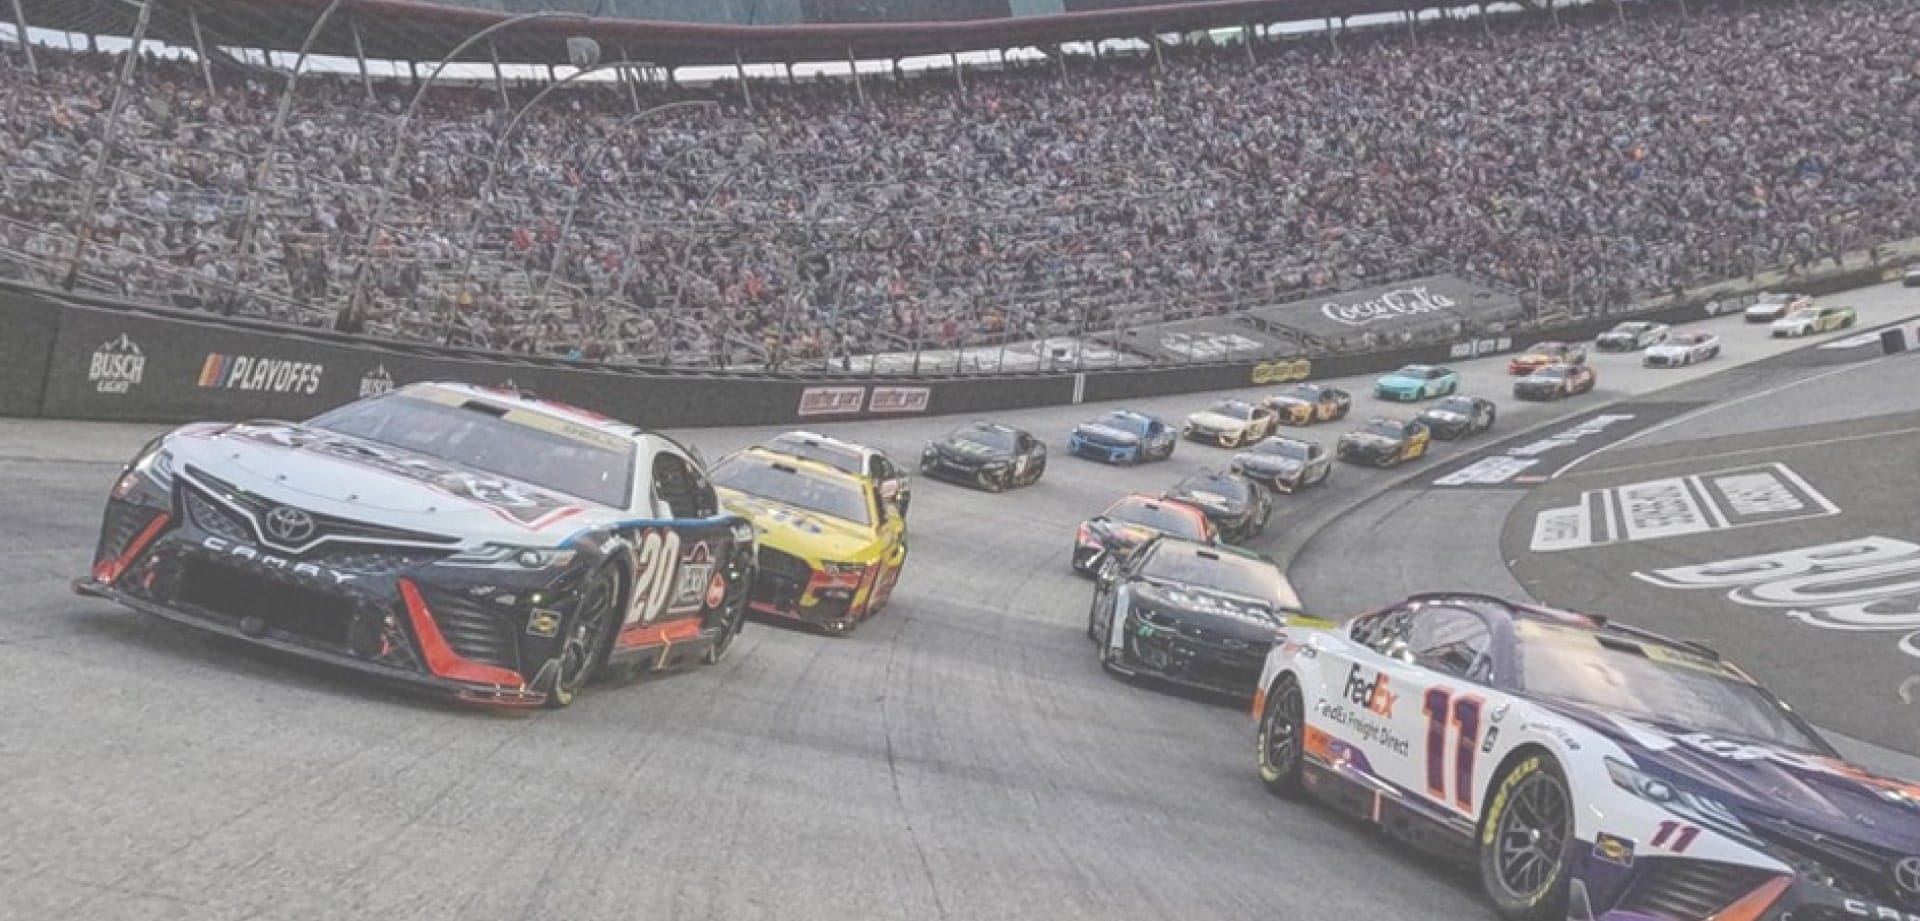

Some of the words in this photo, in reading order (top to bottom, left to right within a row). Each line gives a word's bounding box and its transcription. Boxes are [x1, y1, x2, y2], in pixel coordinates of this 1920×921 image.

[89, 352, 145, 384] BUSCH
[227, 355, 323, 395] PLAYOFFS
[203, 536, 357, 584] CAMRY
[624, 530, 680, 622] 20
[1343, 662, 1398, 718] FedEx
[1379, 727, 1409, 757] Direct
[1423, 685, 1486, 816] 11
[1650, 819, 1701, 853] 11
